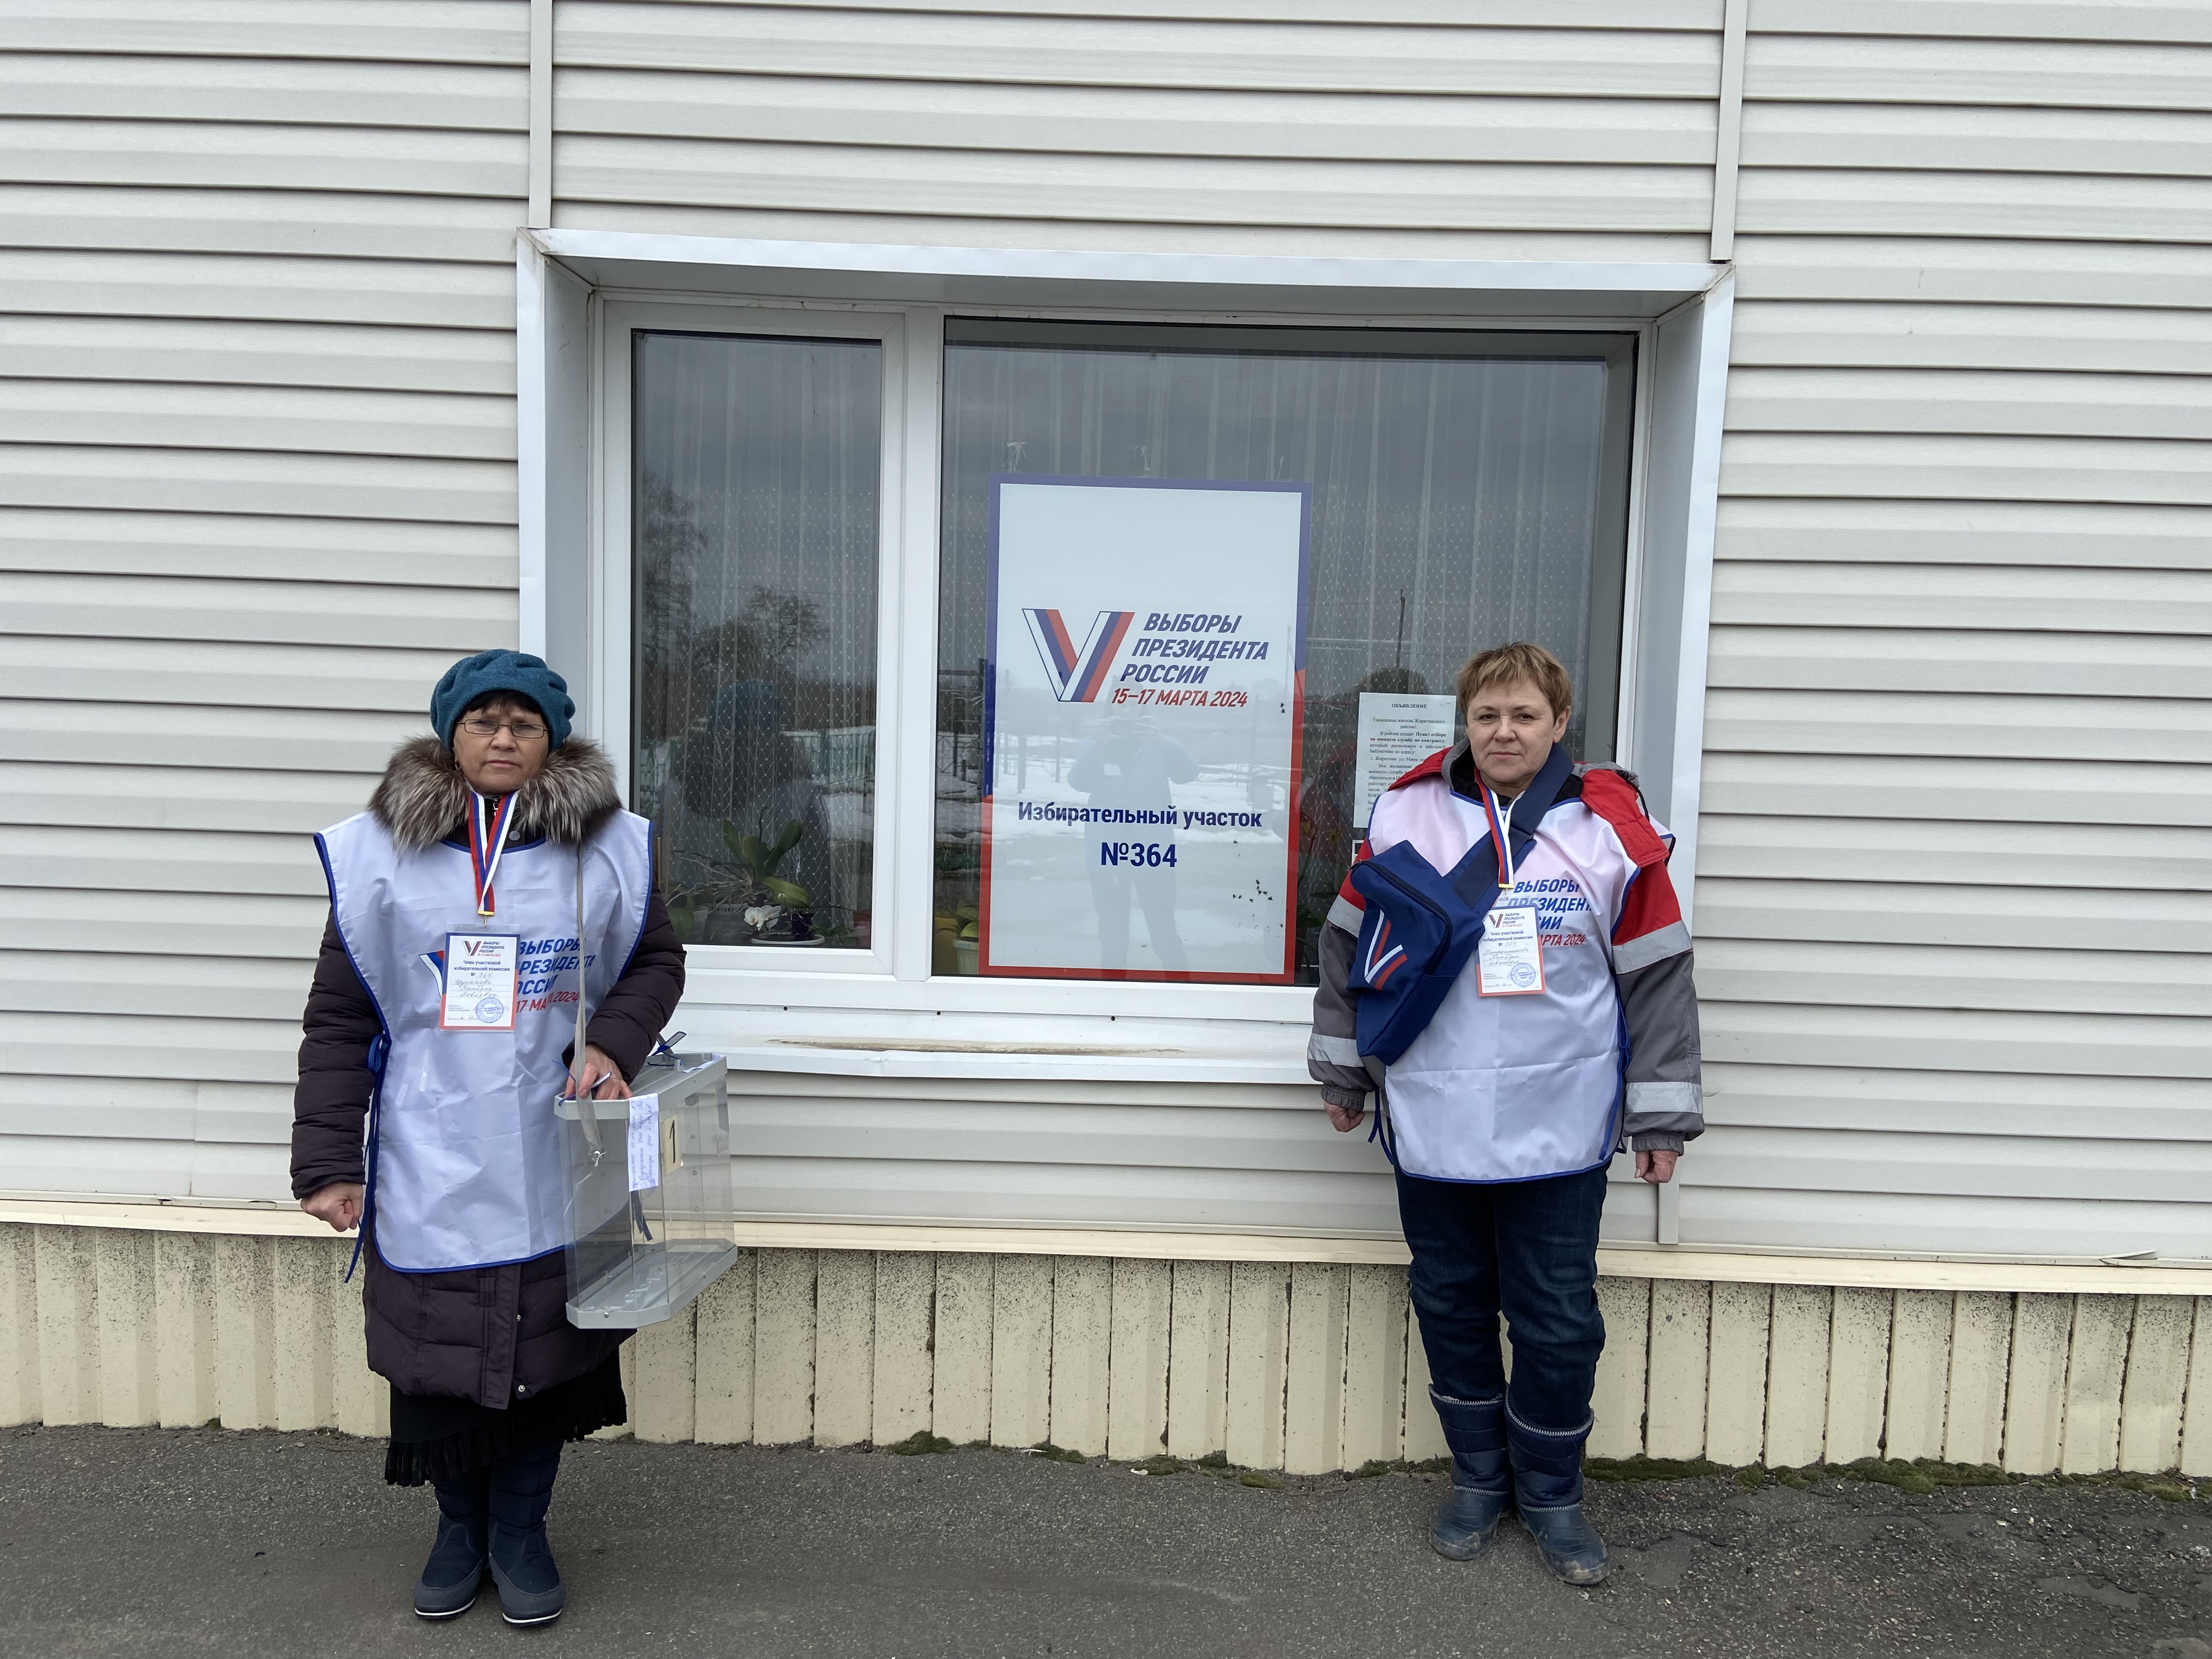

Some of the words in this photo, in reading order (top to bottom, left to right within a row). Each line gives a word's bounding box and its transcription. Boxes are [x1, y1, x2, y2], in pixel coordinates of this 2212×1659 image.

[1143, 613, 1242, 633] ВЫБОРЫ
[1131, 638, 1269, 661] ПРЕЗИДЕНТА
[1120, 664, 1210, 684] РОССИИ
[1155, 690, 1207, 707] МАРТА
[1209, 691, 1248, 707] 2024
[1018, 802, 1177, 826] Избирательный
[1183, 810, 1263, 830] участок
[1101, 842, 1177, 867] №364
[1513, 879, 1579, 893] ВЫБОРЫ
[1563, 934, 1586, 946] 2024
